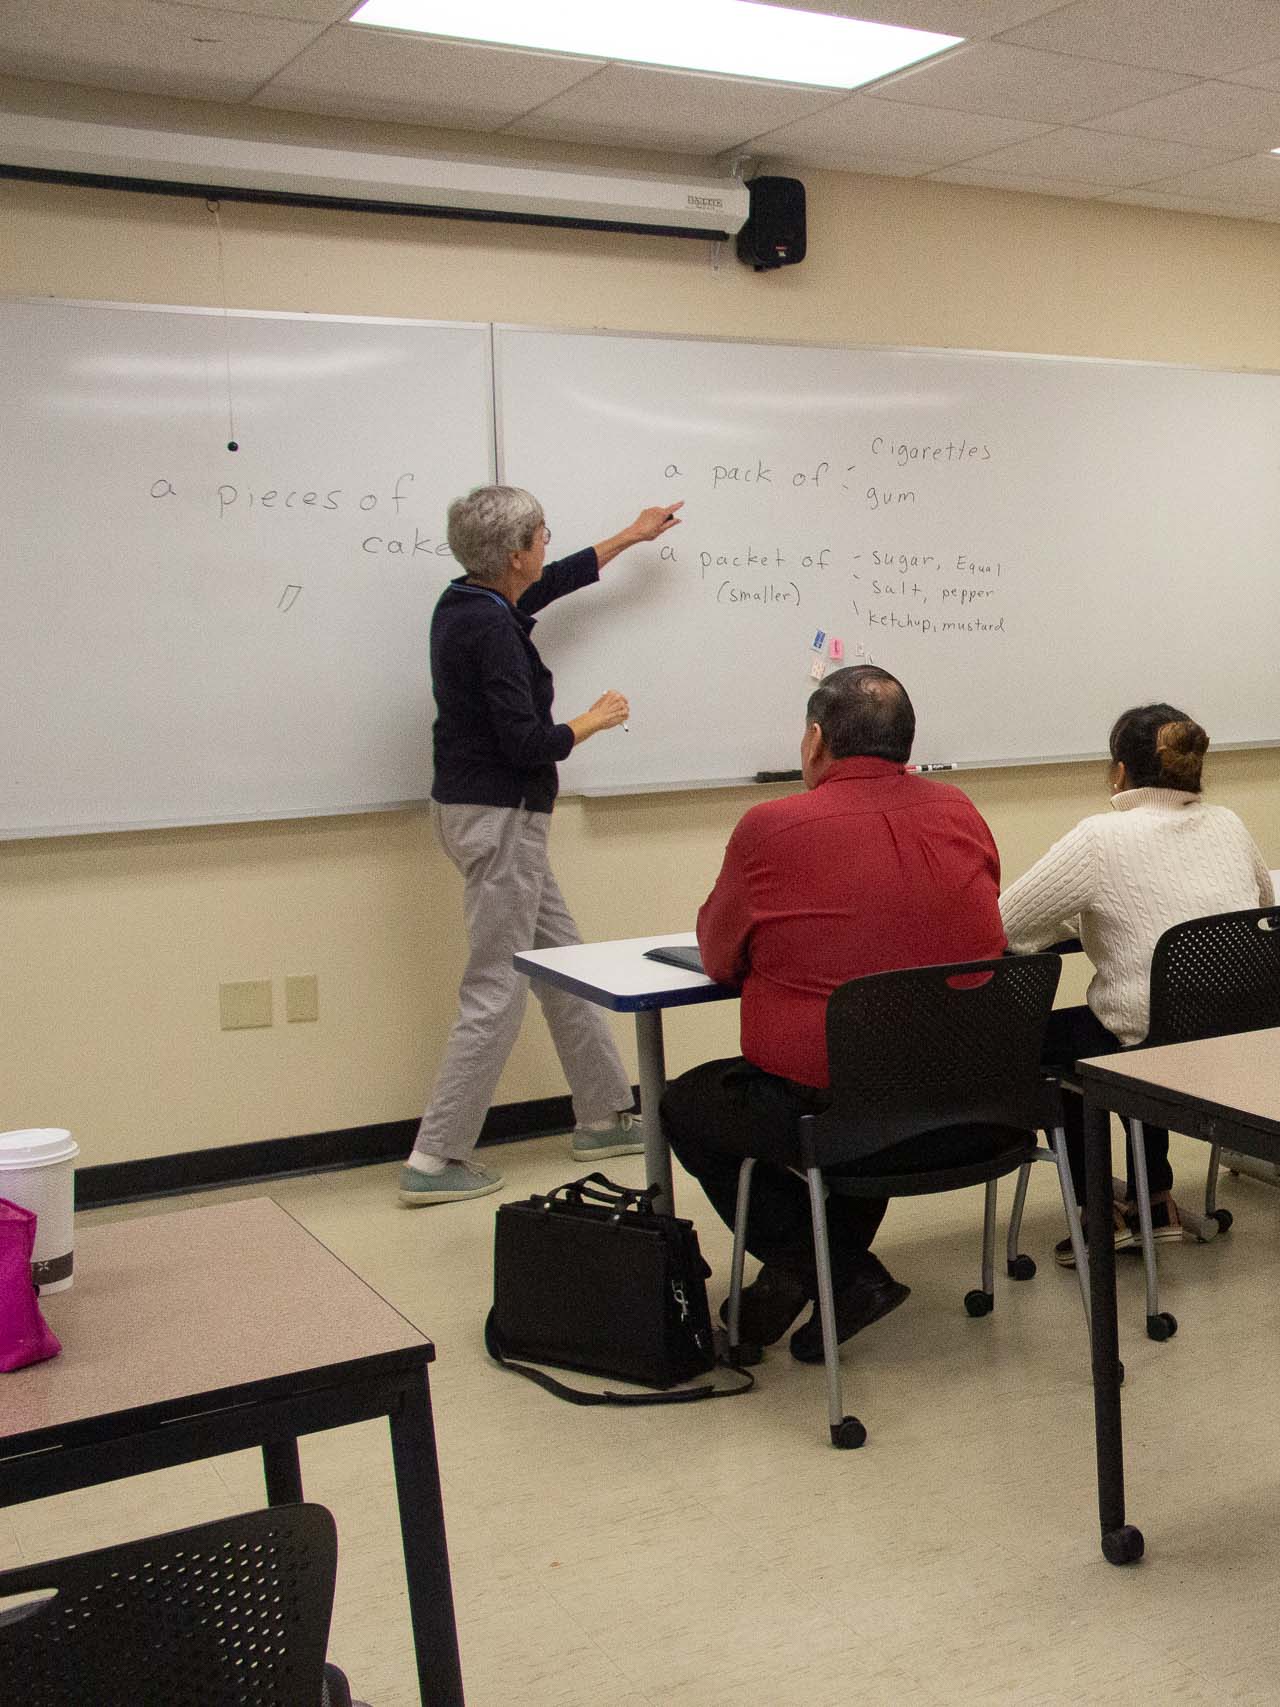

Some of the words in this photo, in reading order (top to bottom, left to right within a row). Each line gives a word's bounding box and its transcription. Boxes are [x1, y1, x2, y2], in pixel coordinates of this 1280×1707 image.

[664, 464, 684, 479] a
[712, 459, 773, 489] pack
[792, 462, 830, 487] of
[150, 478, 177, 499] a
[217, 485, 341, 519] pieces
[360, 472, 415, 514] of
[866, 487, 916, 510] gum
[361, 527, 453, 559] cake
[660, 546, 680, 562] a
[700, 547, 786, 579] packet
[801, 549, 832, 570] of
[956, 555, 1002, 577] Equal
[942, 588, 995, 605] pepper
[942, 617, 1007, 633] mustard
